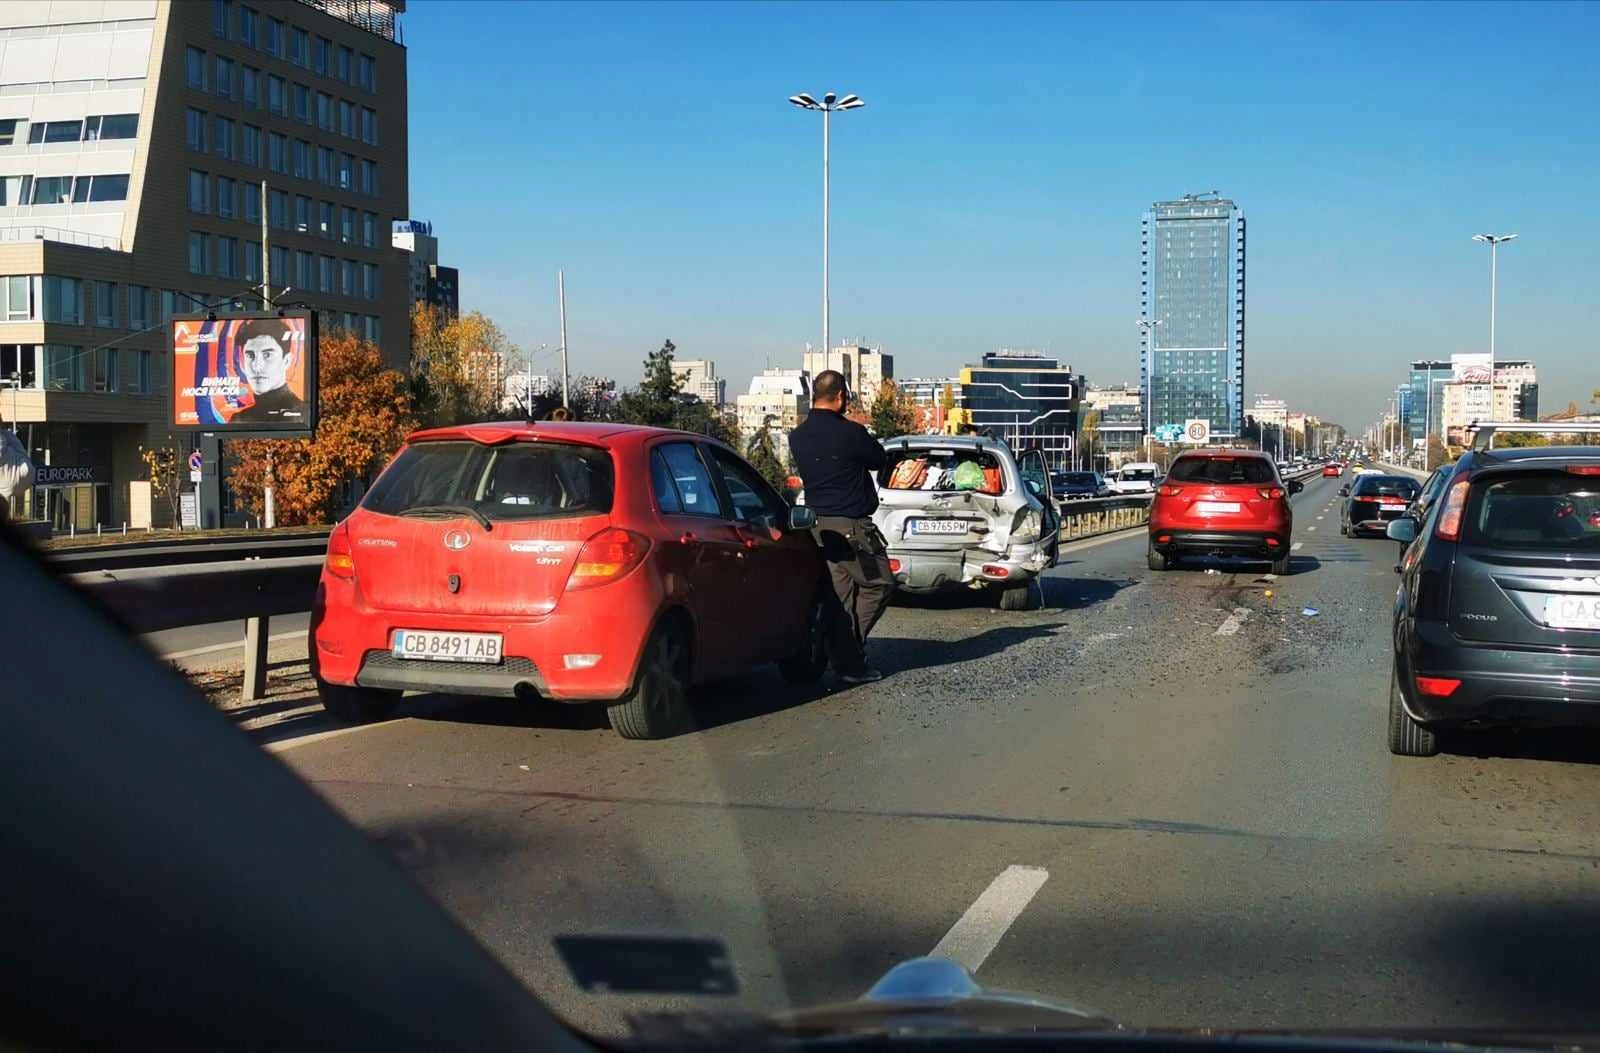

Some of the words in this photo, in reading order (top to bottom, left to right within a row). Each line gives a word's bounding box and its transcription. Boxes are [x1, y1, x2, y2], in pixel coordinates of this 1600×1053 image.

[202, 377, 241, 386] ВИНАГИ
[181, 387, 208, 397] НОСЯ
[208, 387, 241, 397] КАСКА
[37, 467, 93, 481] EUROPARK
[1560, 600, 1586, 620] CA
[405, 635, 426, 653] CB
[430, 636, 470, 655] 8491
[475, 638, 497, 656] AB
